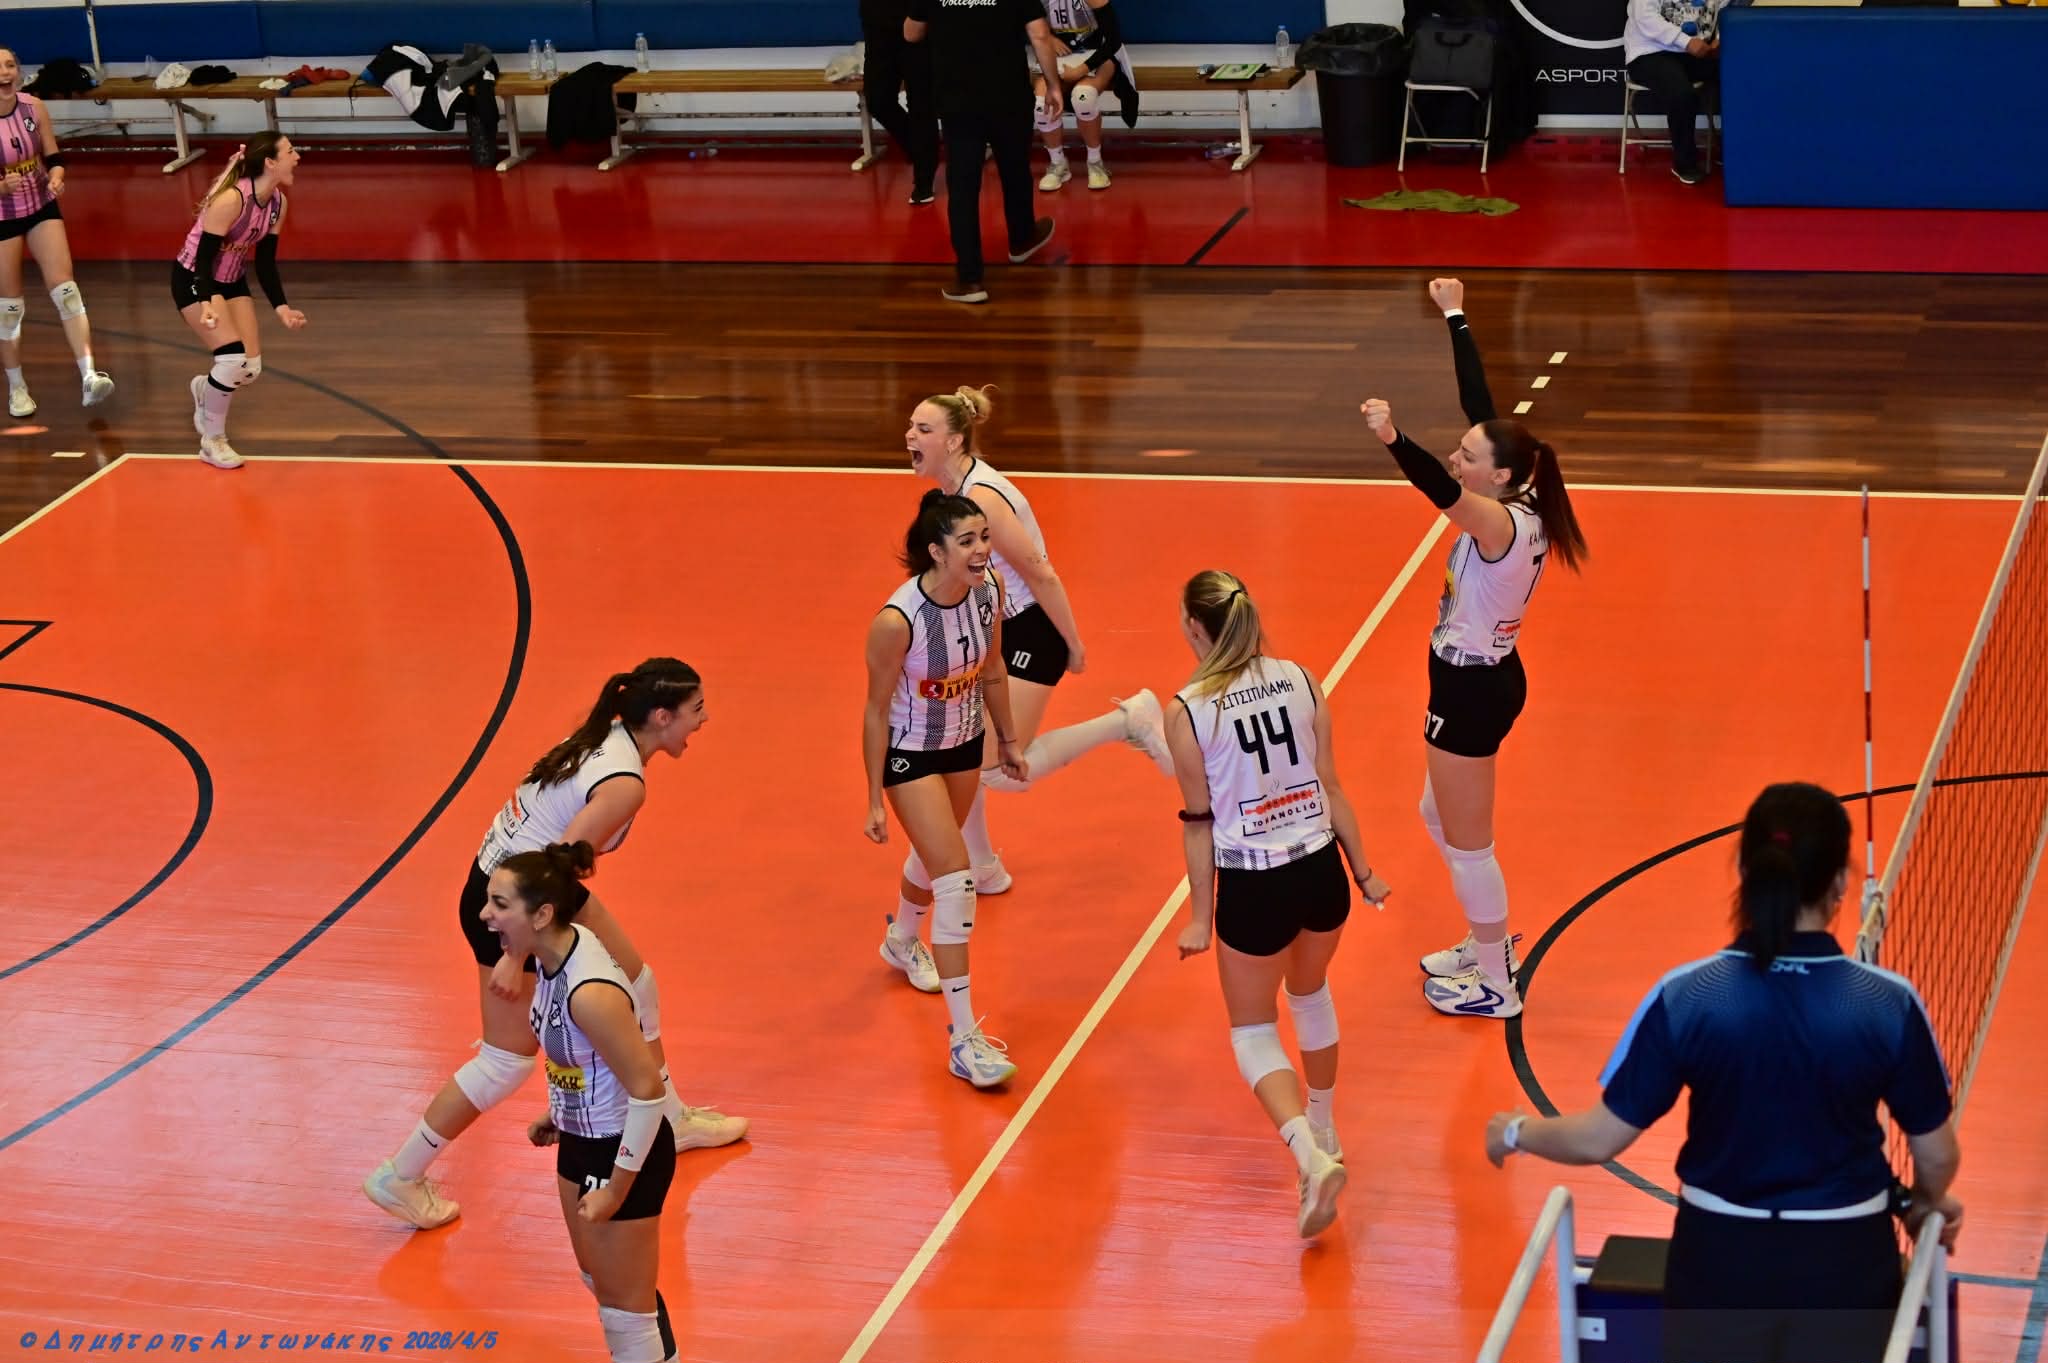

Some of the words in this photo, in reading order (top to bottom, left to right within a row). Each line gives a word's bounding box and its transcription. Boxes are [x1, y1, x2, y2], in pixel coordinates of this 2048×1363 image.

[1054, 9, 1068, 24] 16
[10, 137, 23, 155] 4
[957, 635, 969, 673] 7
[1011, 650, 1032, 669] 10
[1234, 705, 1299, 775] 44
